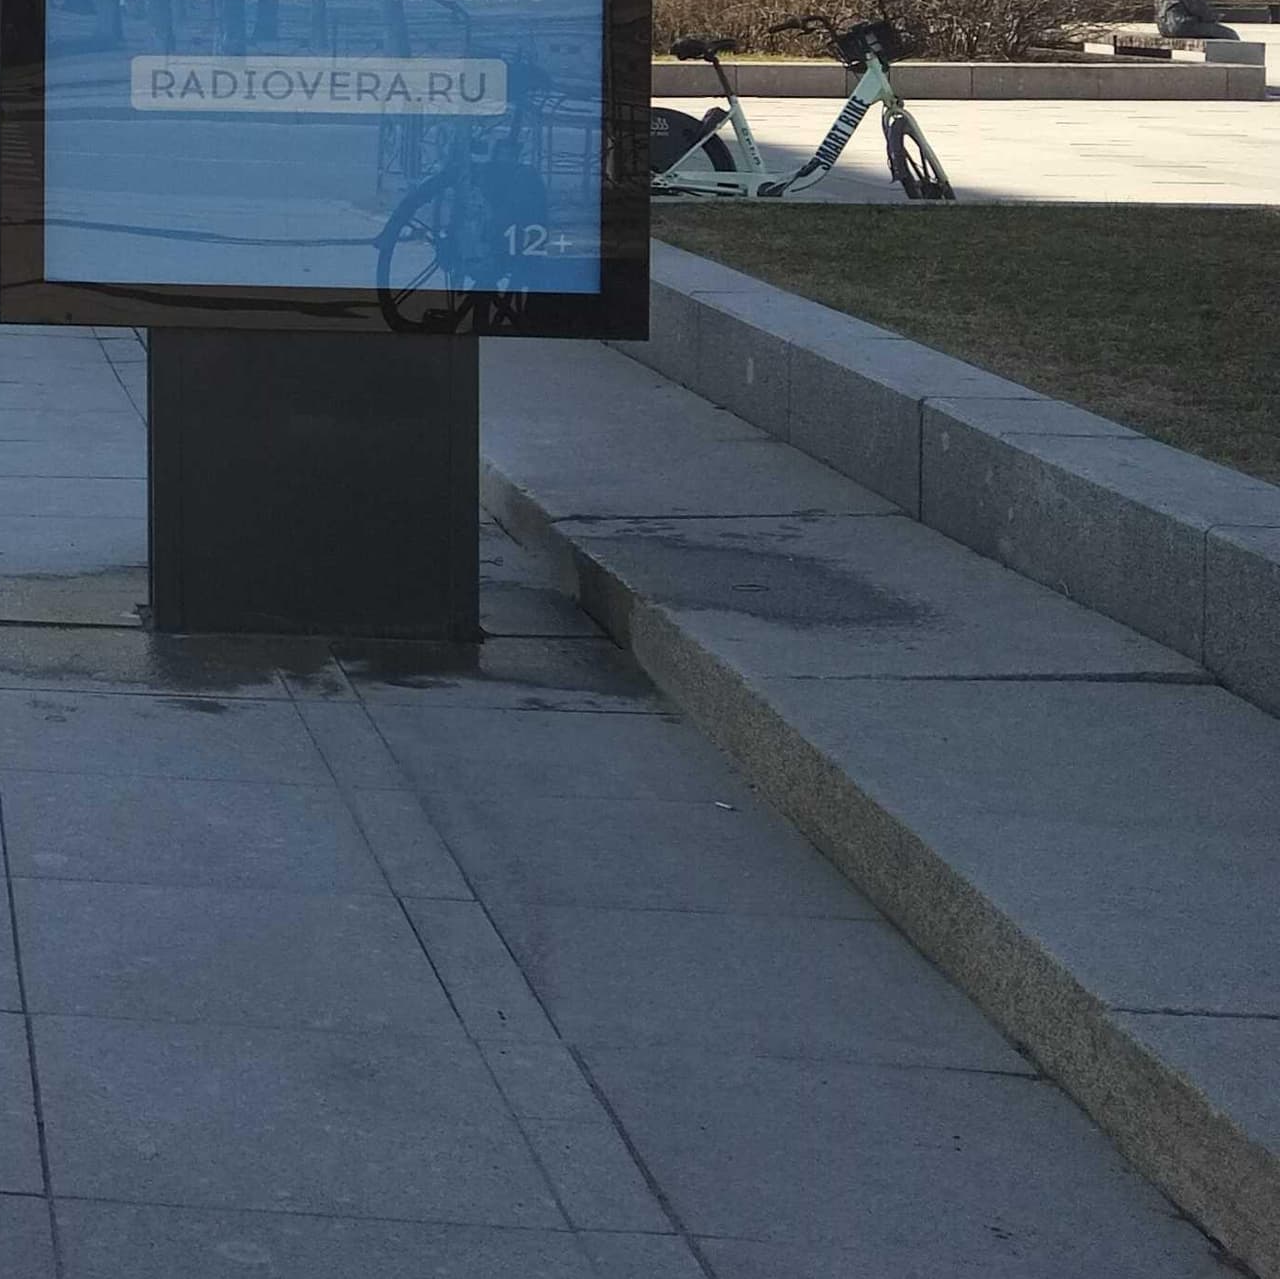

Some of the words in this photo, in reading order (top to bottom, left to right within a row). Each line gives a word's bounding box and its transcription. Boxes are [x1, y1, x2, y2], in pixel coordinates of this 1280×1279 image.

[150, 68, 487, 104] RADIOVERA.RU
[814, 124, 852, 171] SMART
[838, 95, 871, 130] BIKE
[503, 223, 574, 257] 12+
